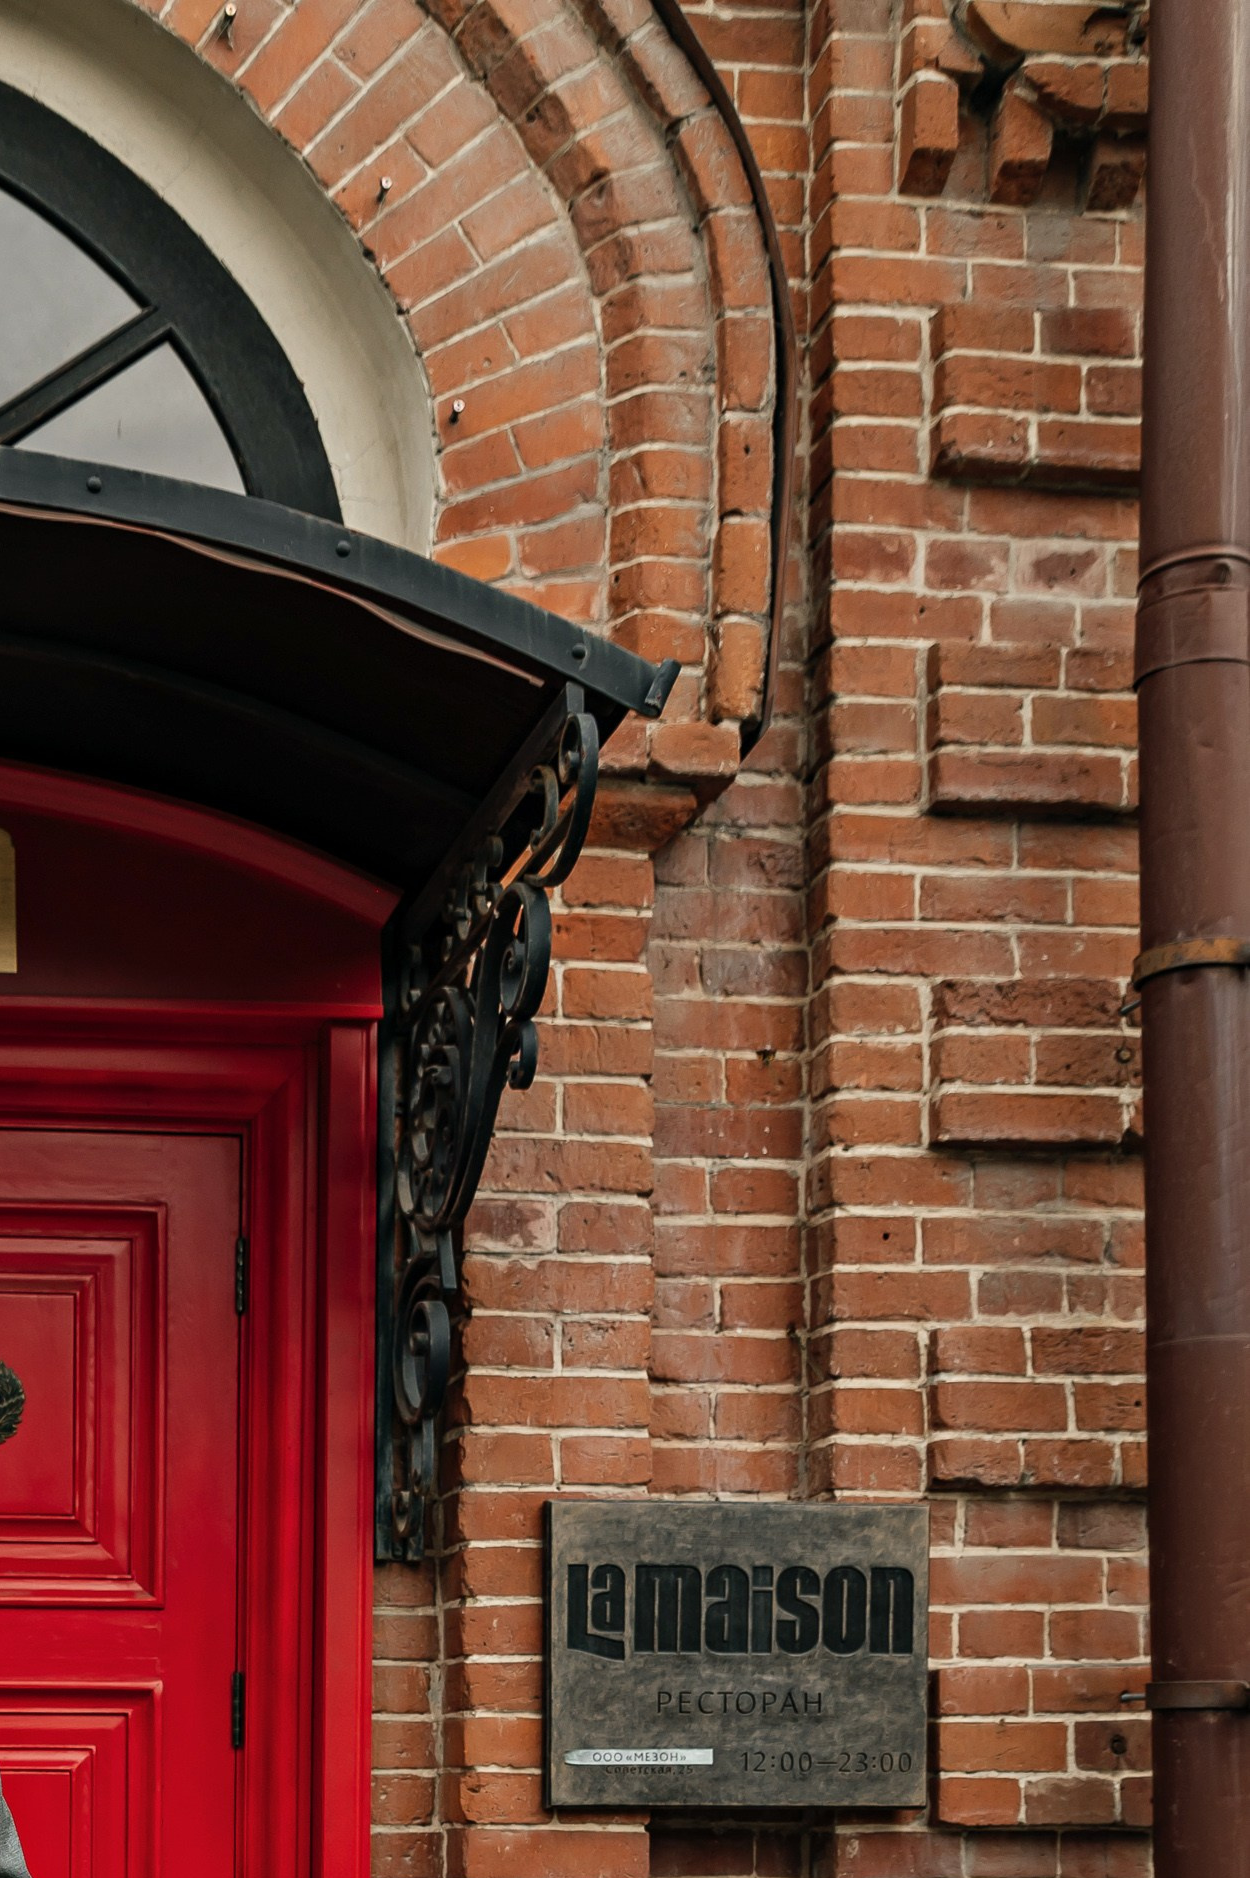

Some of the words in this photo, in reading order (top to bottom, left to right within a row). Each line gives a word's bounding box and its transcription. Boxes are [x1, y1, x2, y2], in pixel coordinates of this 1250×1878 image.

[567, 1564, 626, 1661] La
[634, 1564, 915, 1655] maison
[657, 1692, 823, 1714] РЕСТОРАН
[592, 1752, 623, 1762] ООО
[626, 1752, 687, 1762] «МЕЗОН»
